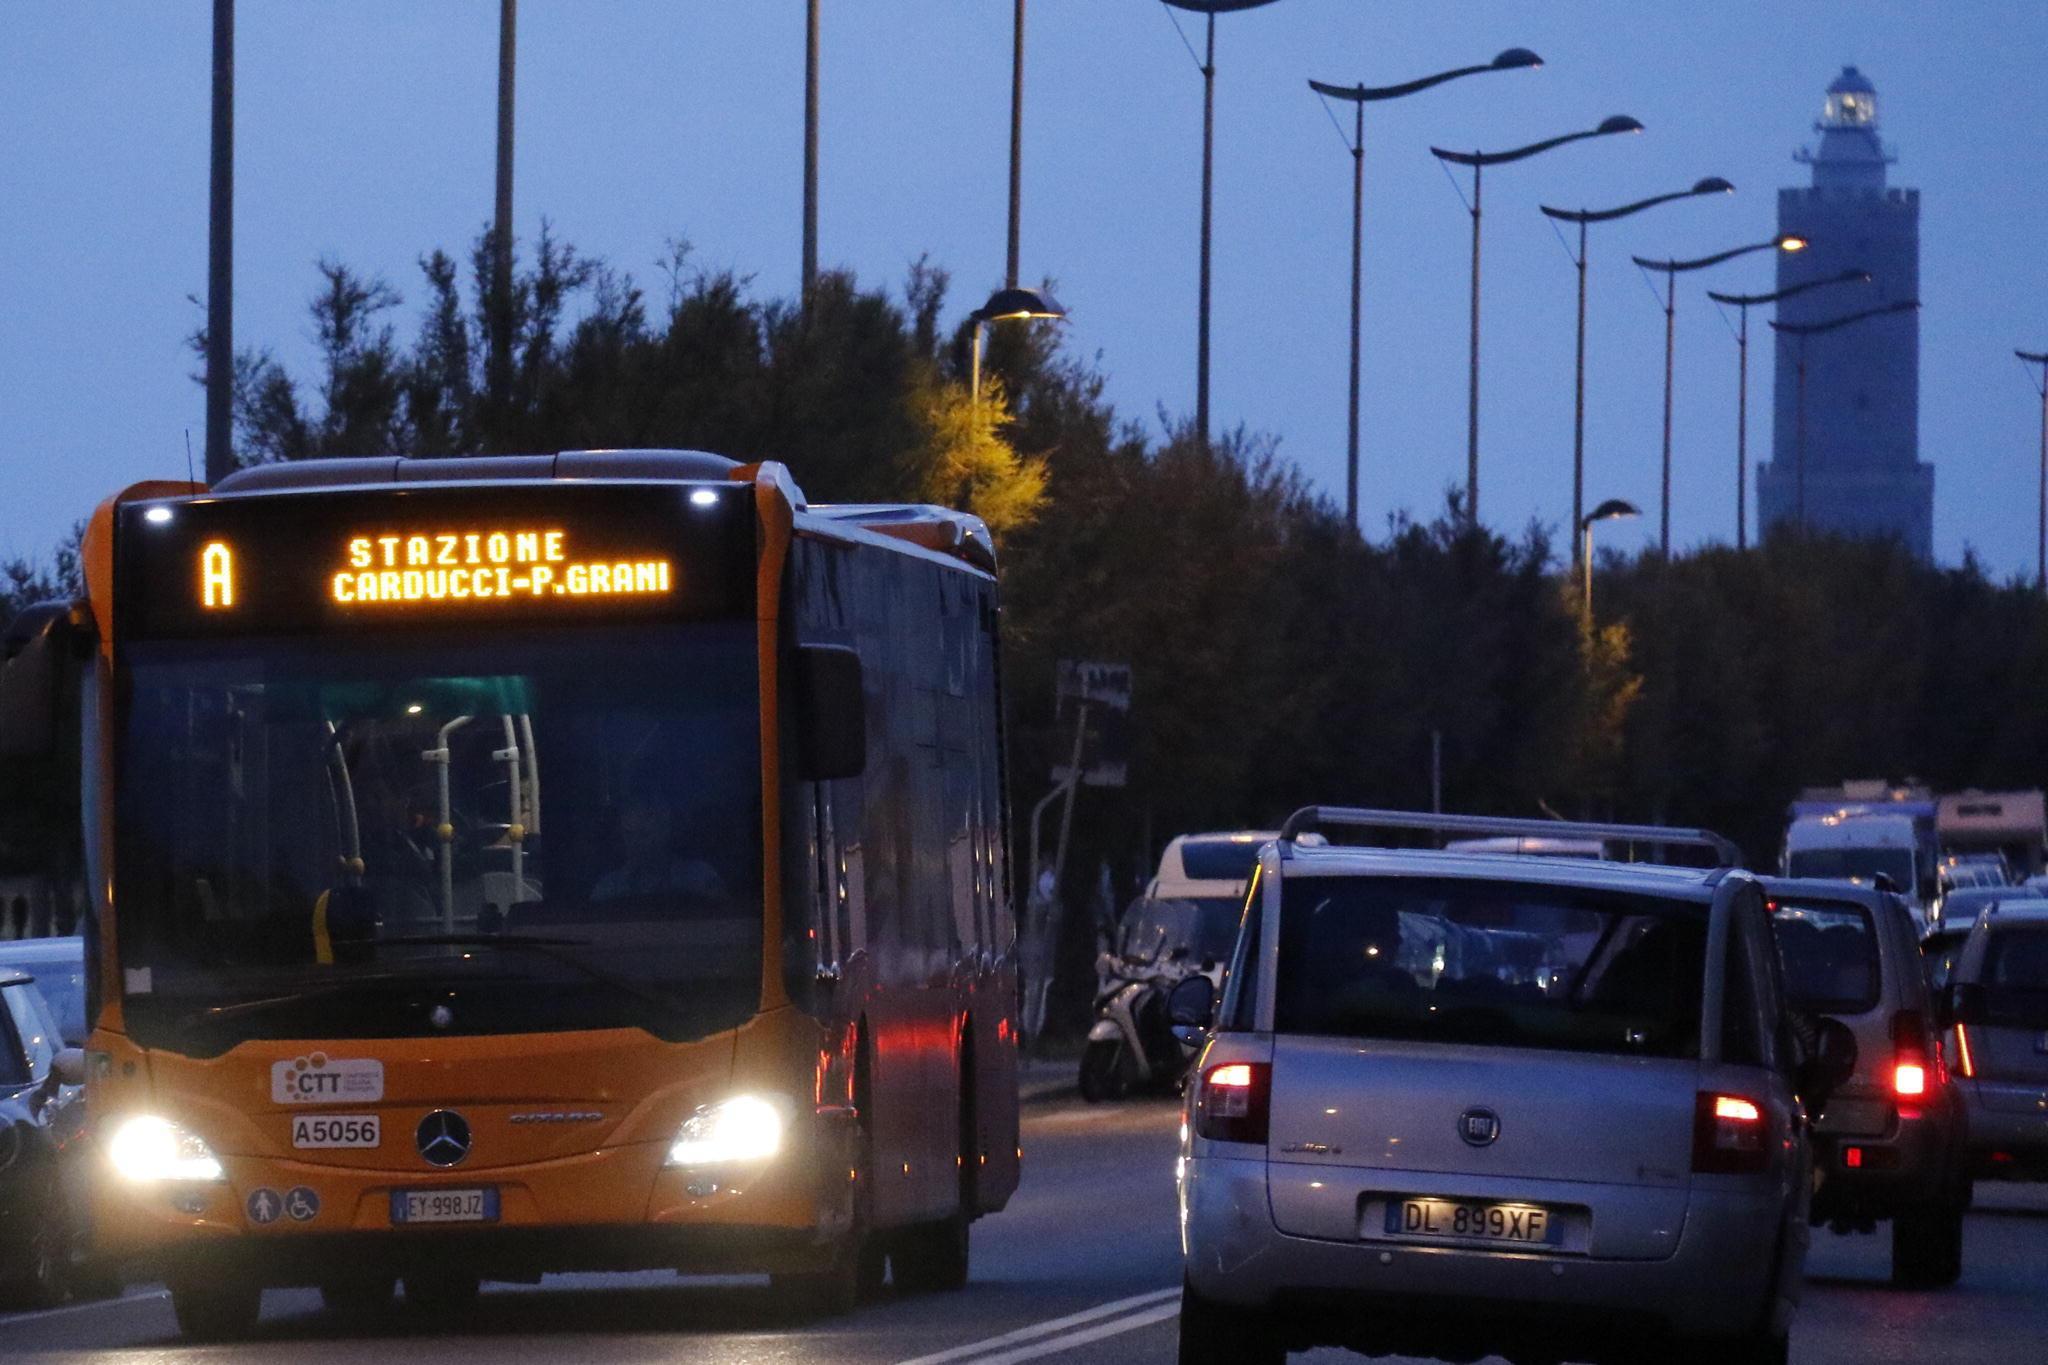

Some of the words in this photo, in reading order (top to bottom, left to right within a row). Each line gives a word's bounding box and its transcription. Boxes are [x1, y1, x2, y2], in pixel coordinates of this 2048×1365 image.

[350, 532, 564, 567] STAZIONE
[203, 543, 232, 607] A
[299, 1073, 341, 1093] CTT
[295, 1120, 375, 1142] A5056
[1406, 1203, 1440, 1233] DL
[1453, 1207, 1543, 1239] 899XF
